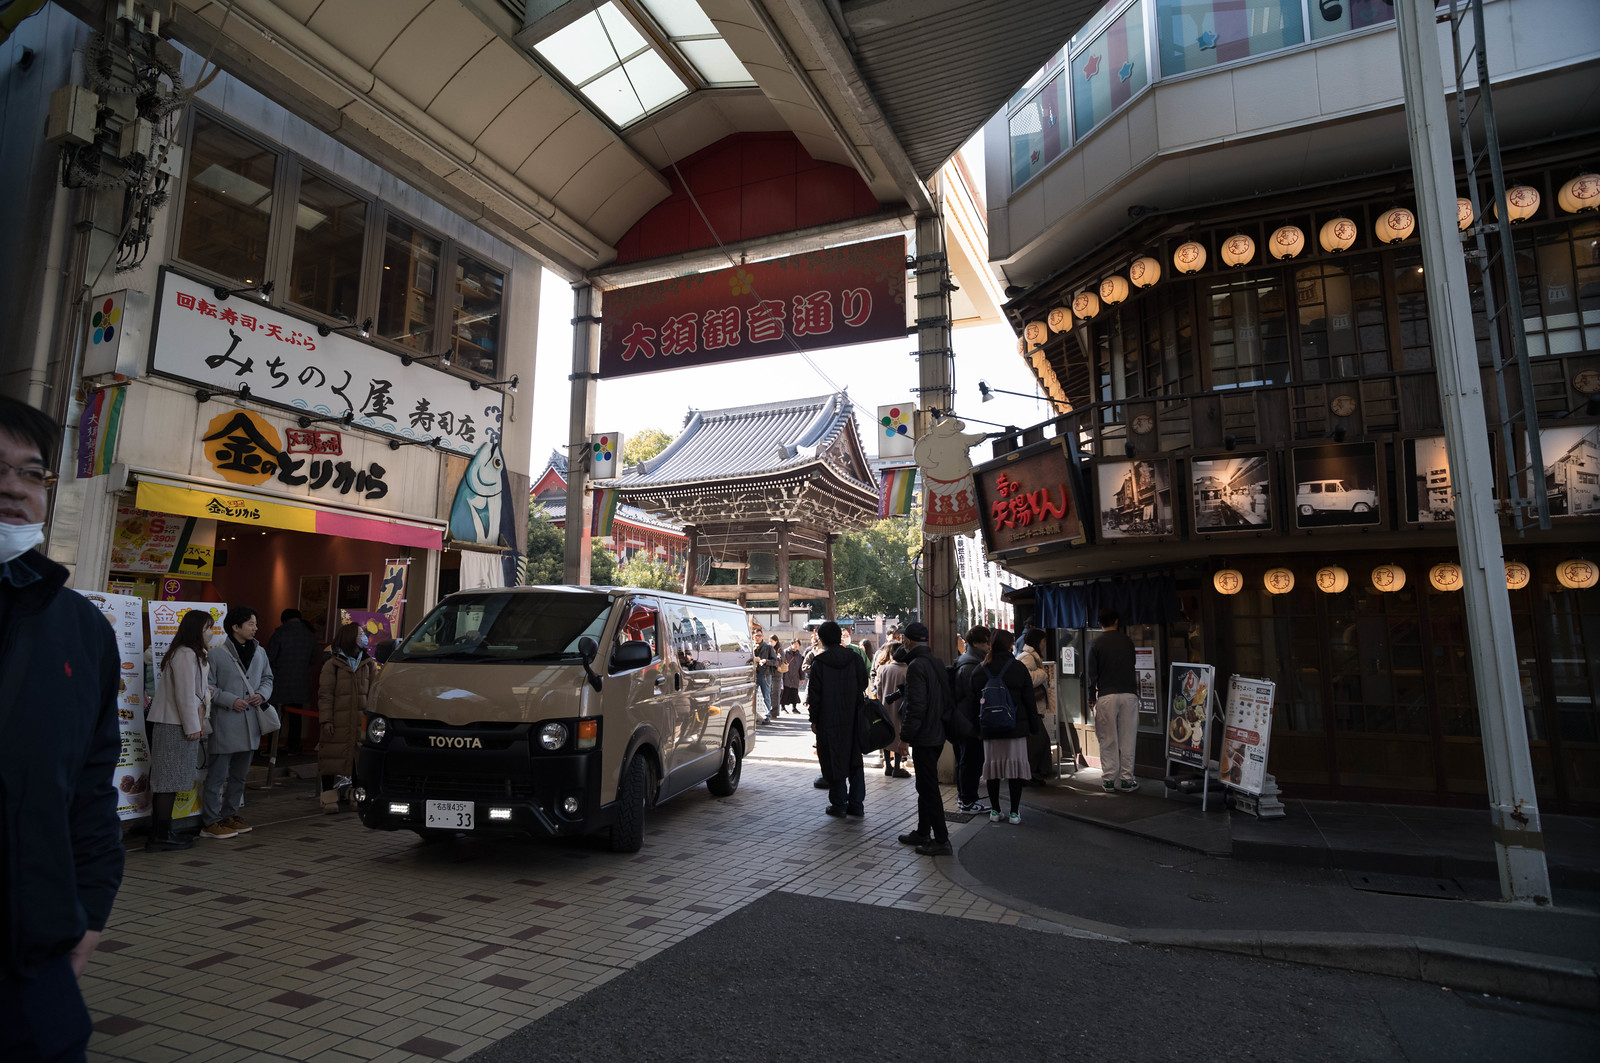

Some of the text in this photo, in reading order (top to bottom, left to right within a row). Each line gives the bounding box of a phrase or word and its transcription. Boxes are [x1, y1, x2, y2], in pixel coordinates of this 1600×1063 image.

[176, 291, 316, 351] 回転寿司・天ぷら
[621, 287, 873, 361] 大須観音通り
[205, 328, 476, 444] みちのく屋 寿司店
[202, 412, 388, 500] 金のとりから
[206, 498, 260, 519] 金のとりから
[992, 483, 1067, 532] 矢場とん
[429, 736, 483, 749] TOYOTA
[428, 813, 472, 827] ろ 33
